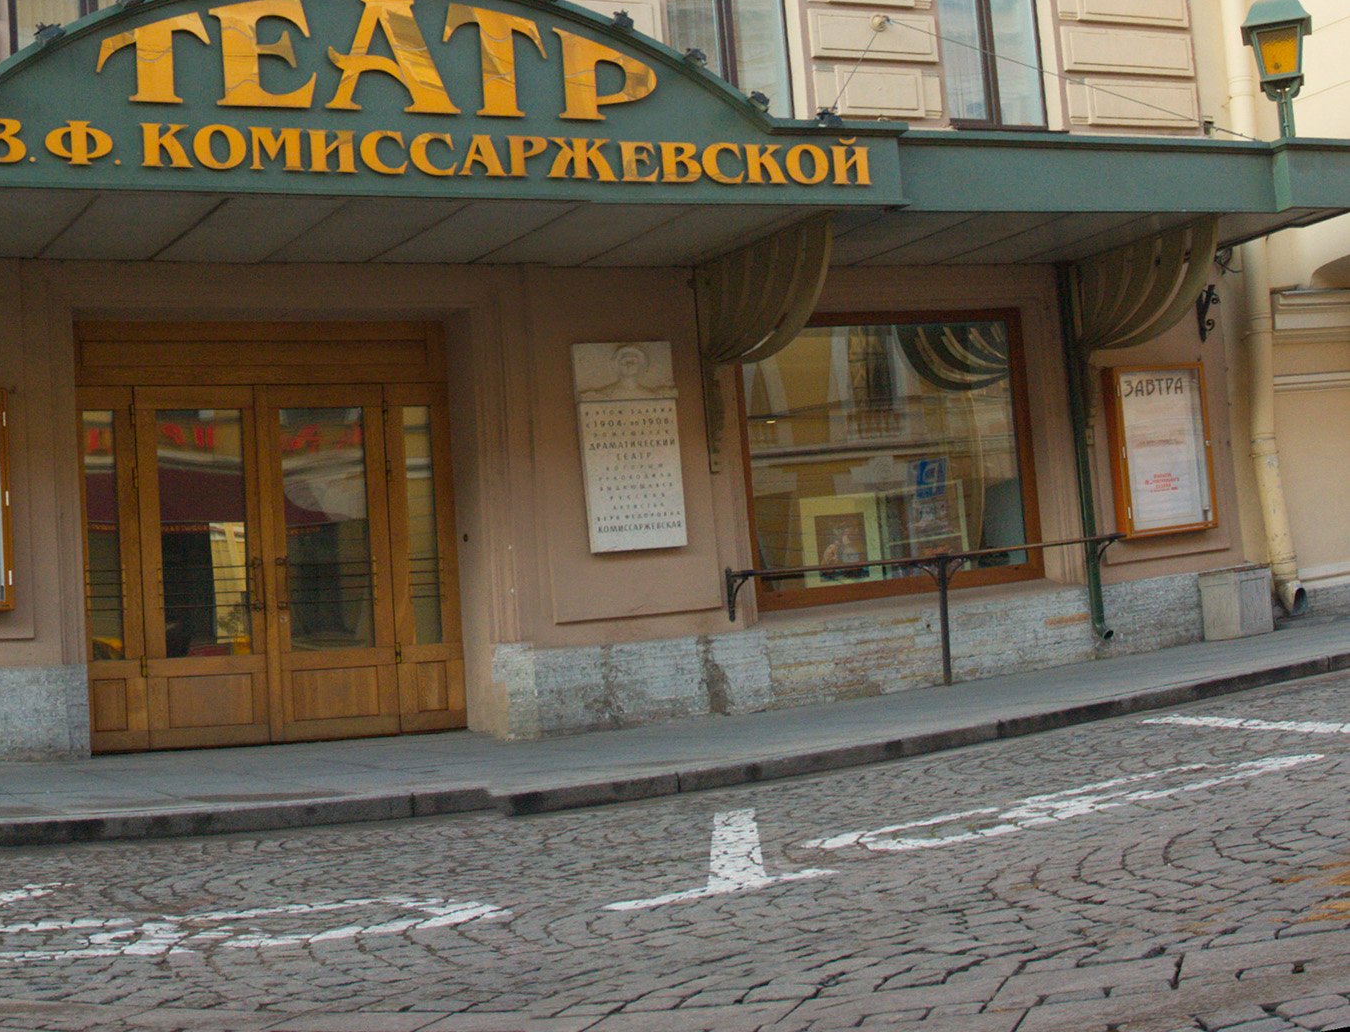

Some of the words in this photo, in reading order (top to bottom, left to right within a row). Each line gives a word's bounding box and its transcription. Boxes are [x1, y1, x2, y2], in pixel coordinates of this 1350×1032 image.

[140, 122, 872, 186] КОМИССАРЖЕВСКОЙ
[1123, 377, 1184, 398] ЗАВТРА
[616, 452, 652, 461] ТЕАТР
[597, 520, 682, 534] КОМИССАРЖЕВСКАЯ
